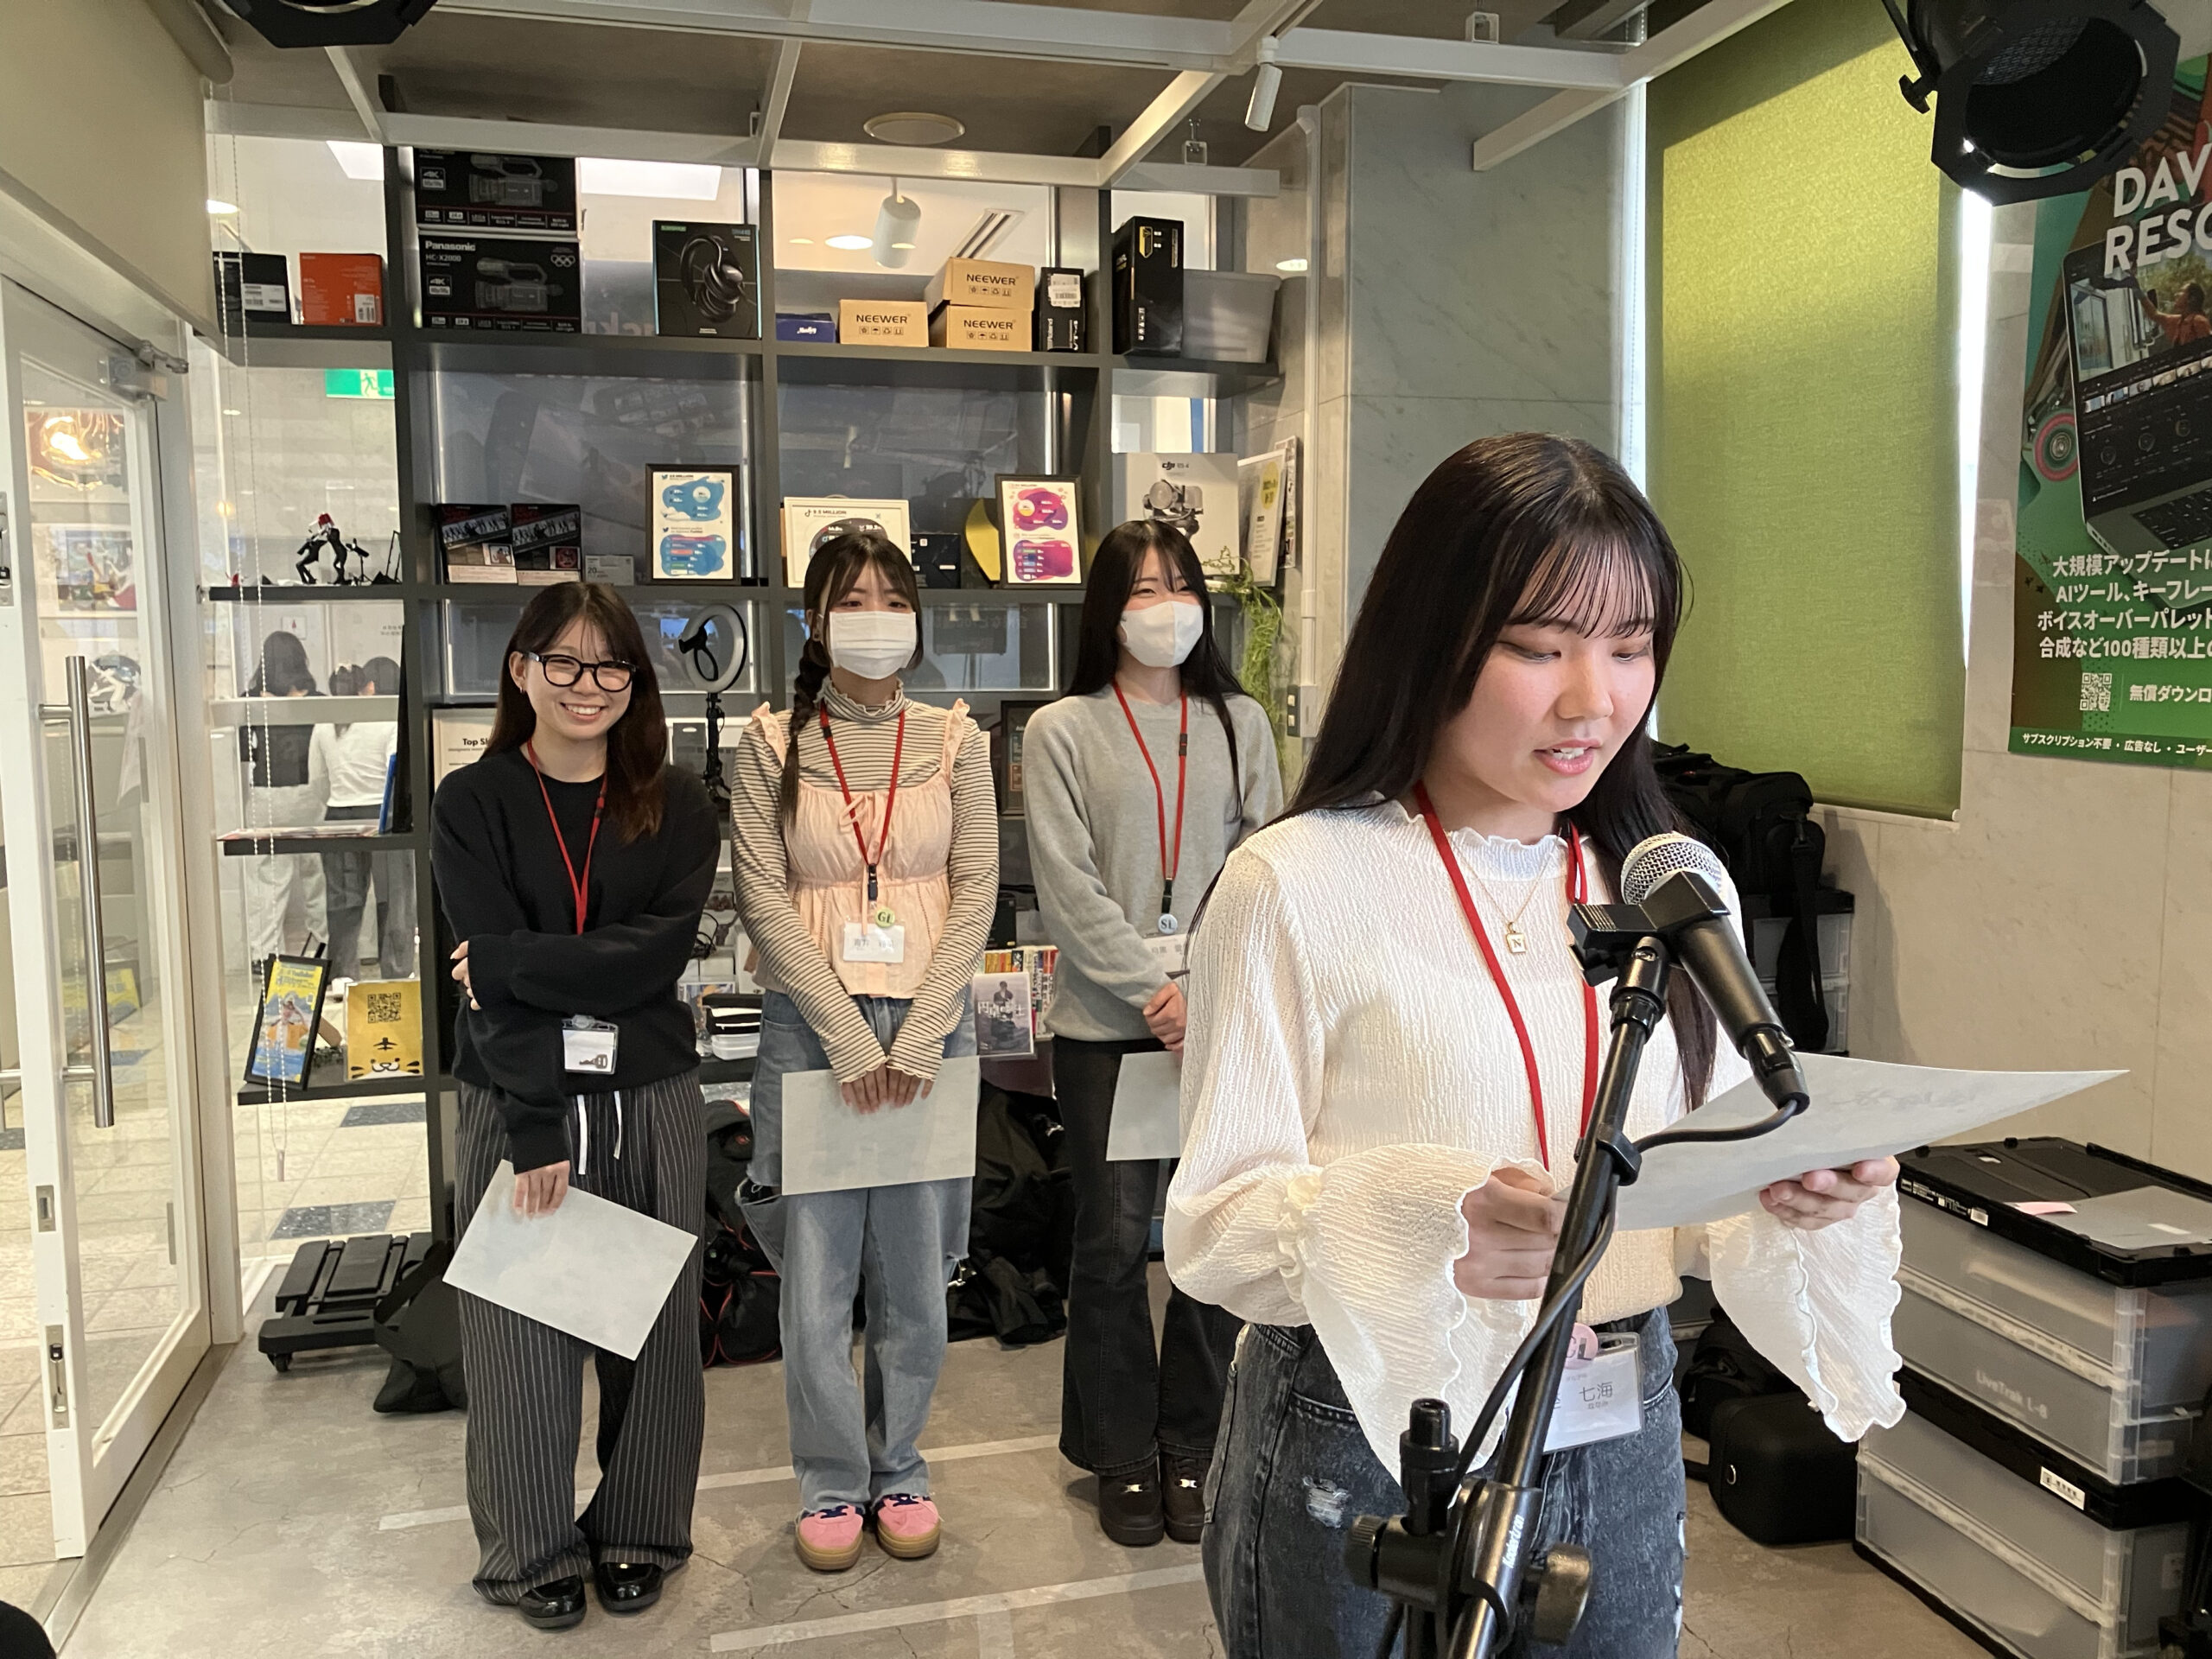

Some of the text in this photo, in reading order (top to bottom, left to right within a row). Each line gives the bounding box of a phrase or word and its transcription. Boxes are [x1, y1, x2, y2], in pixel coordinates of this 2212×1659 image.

[2113, 143, 2212, 218] DAV
[425, 240, 476, 252] Panasonic
[966, 273, 1016, 286] NEEWER
[856, 314, 907, 324] NEEWER
[963, 319, 1014, 330] NEEWER
[462, 738, 479, 747] Top
[1579, 1381, 1613, 1402] 七海
